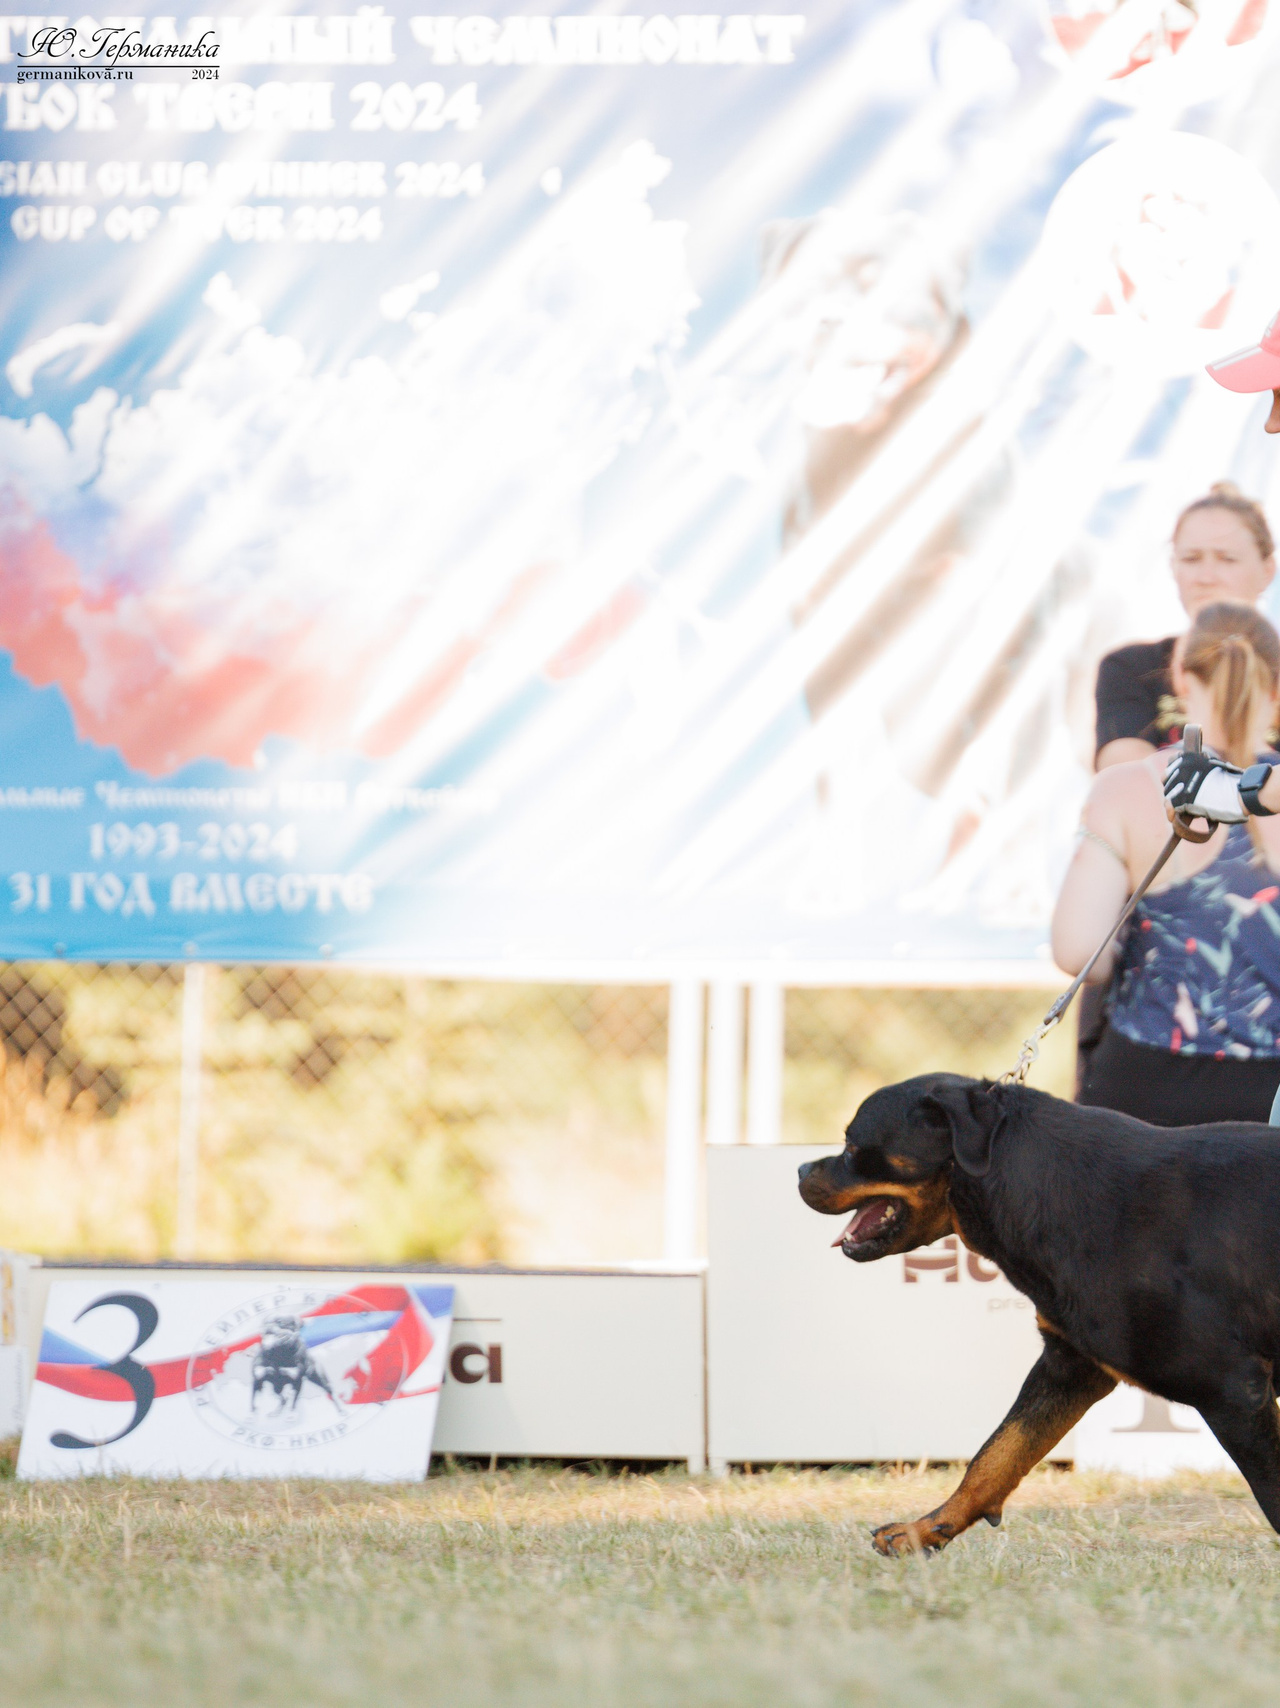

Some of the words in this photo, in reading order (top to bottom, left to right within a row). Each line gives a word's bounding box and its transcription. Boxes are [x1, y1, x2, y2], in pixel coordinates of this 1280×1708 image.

[0, 82, 118, 132] БОК
[349, 81, 482, 132] 2024
[394, 161, 485, 198] 2024
[292, 205, 383, 243] 2024
[89, 822, 299, 860] 1993-2024
[10, 872, 51, 913] 31
[70, 872, 155, 917] ГОД
[50, 1290, 159, 1449] 3
